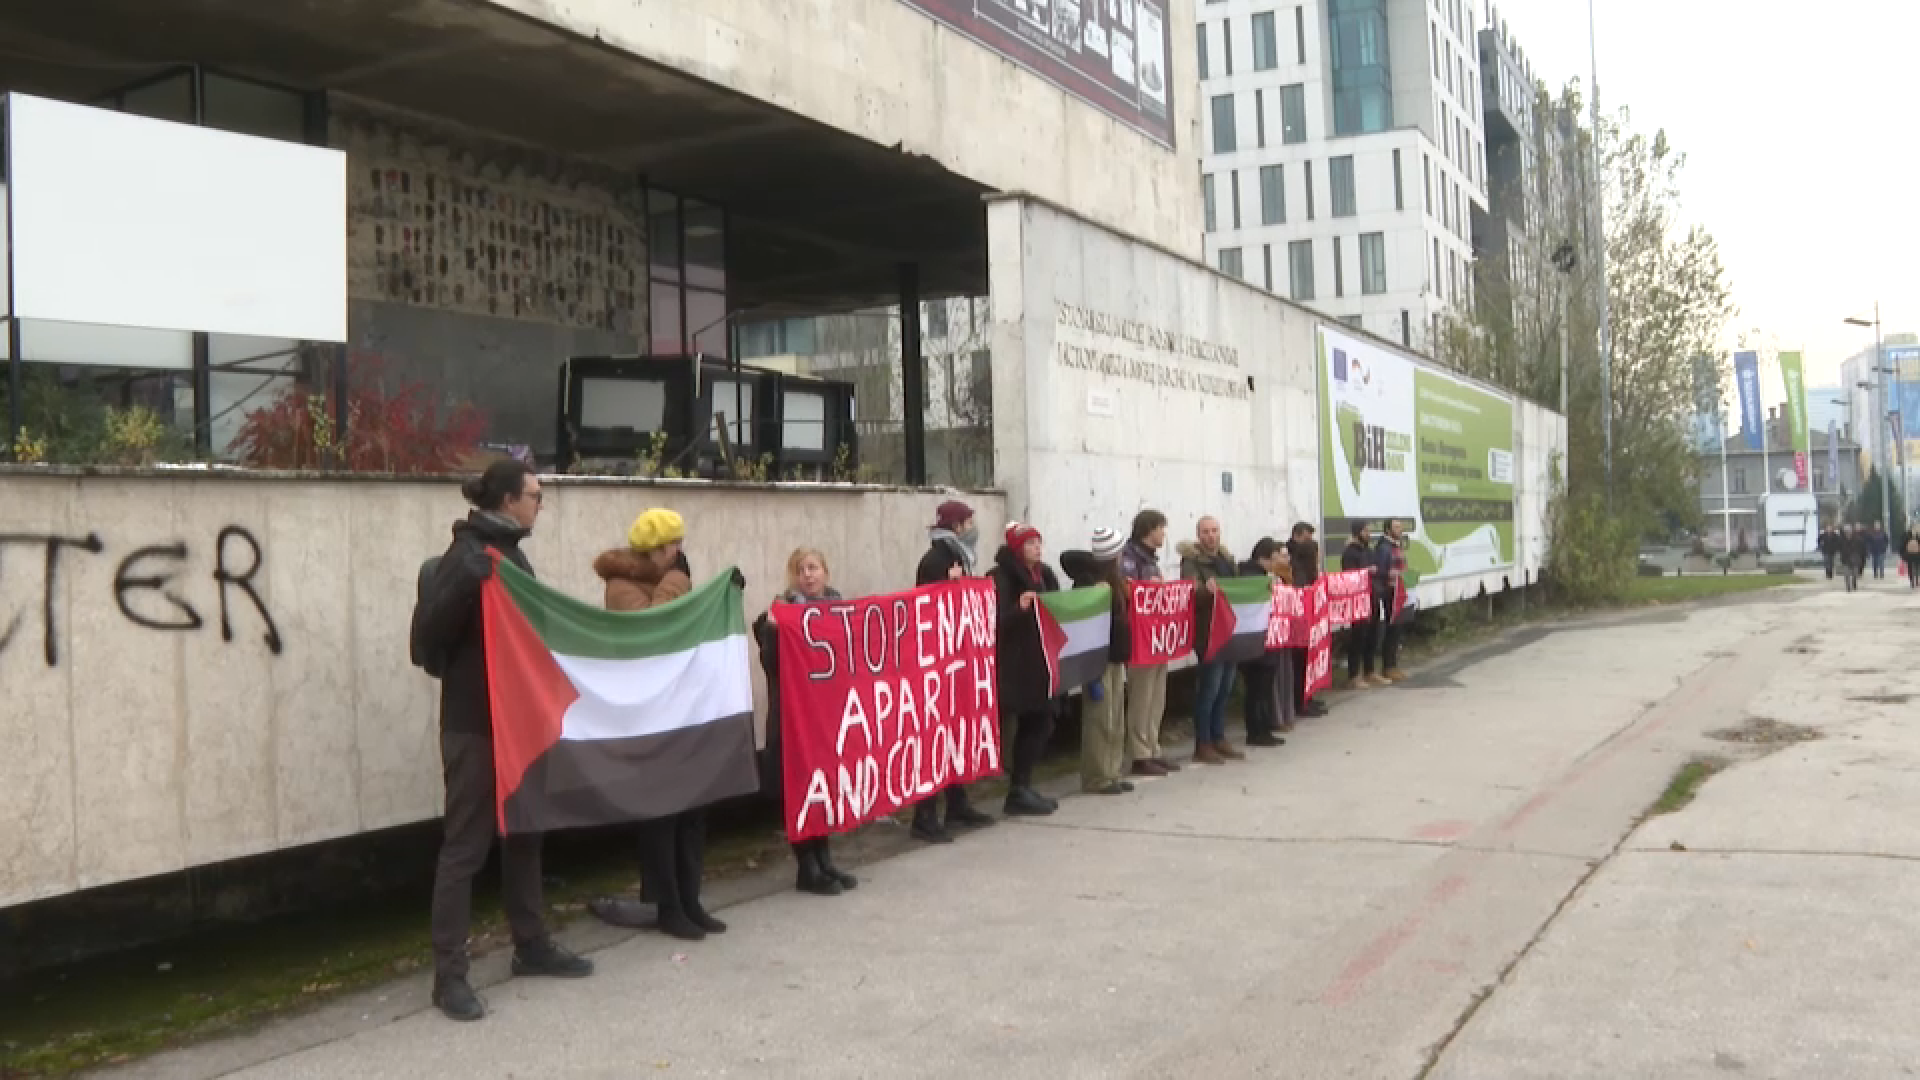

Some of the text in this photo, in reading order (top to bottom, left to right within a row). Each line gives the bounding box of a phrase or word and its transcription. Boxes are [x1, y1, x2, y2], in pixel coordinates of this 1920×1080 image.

[1354, 420, 1385, 470] BiH
[0, 524, 282, 666] TER
[803, 600, 909, 680] STOP
[797, 754, 880, 833] AND
